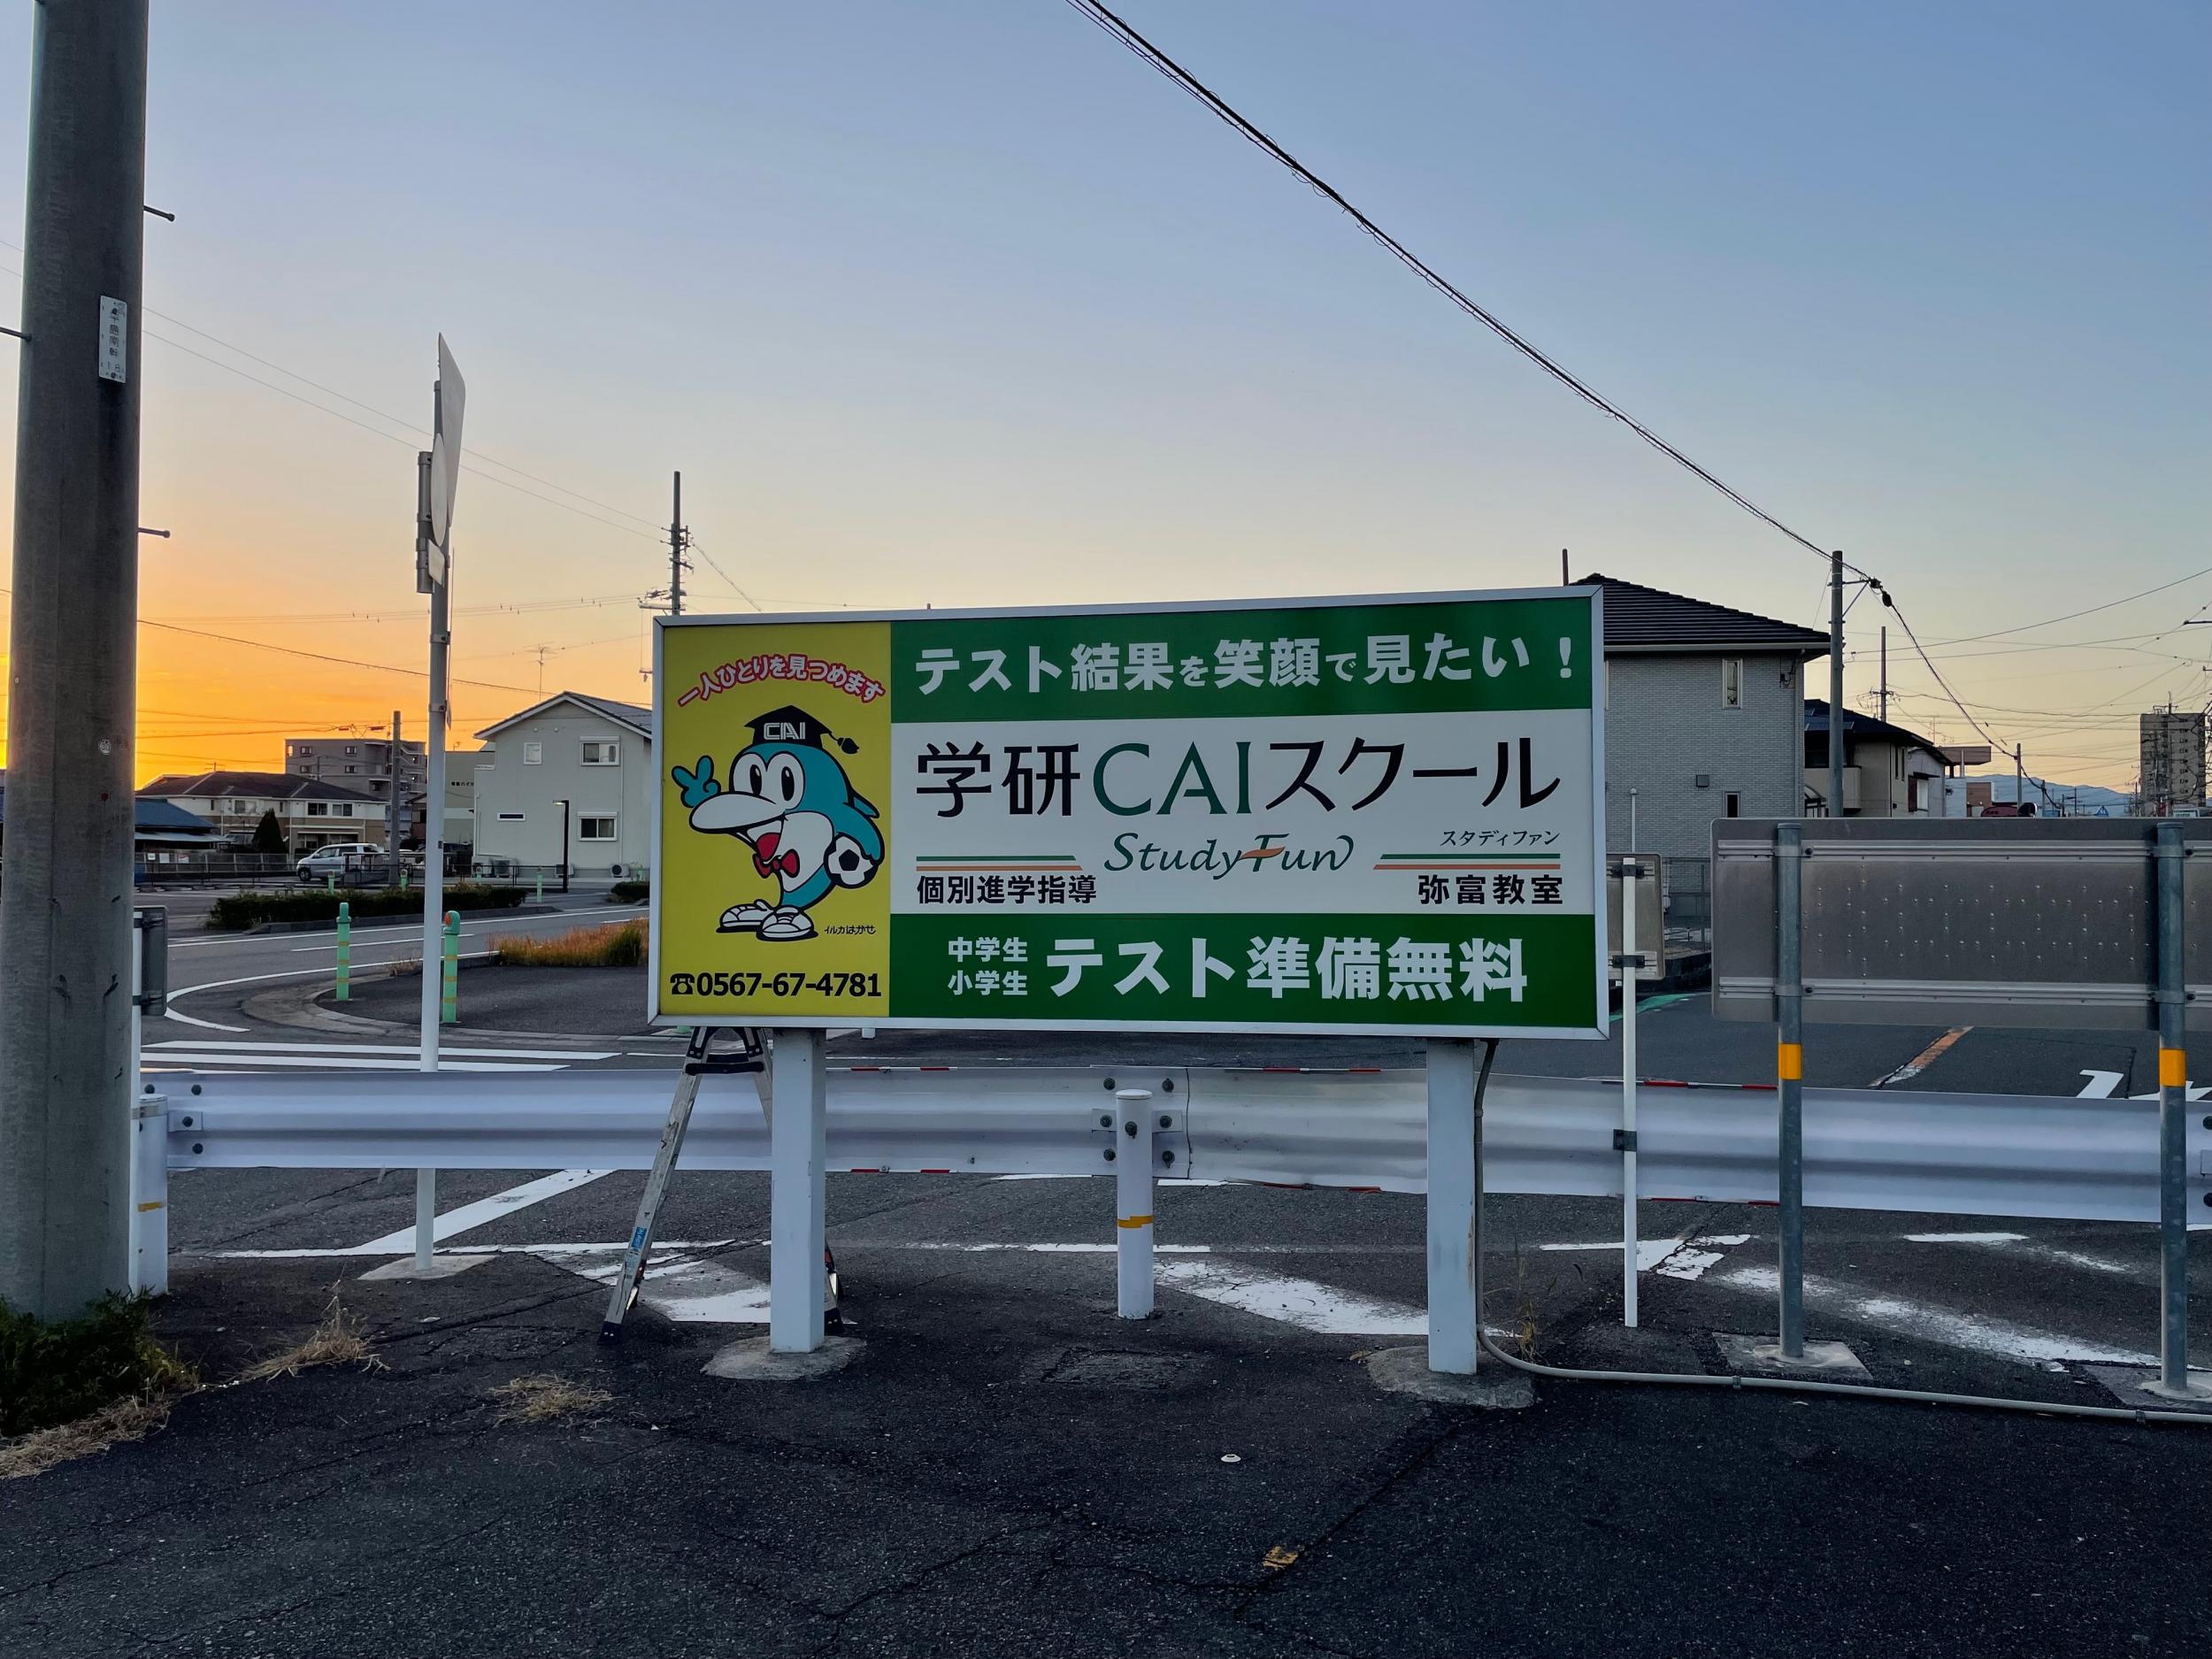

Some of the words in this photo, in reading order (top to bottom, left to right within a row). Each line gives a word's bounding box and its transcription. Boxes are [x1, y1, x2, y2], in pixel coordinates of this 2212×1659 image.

[677, 653, 887, 708] 一人ひとりを見つめます
[764, 722, 806, 741] CAI
[916, 736, 1562, 818] 学研CAIスクール
[1440, 830, 1561, 847] スタディファン
[917, 874, 1097, 904] 個別進学指導
[1417, 873, 1563, 905] 弥富教室
[824, 925, 877, 935] イルカはかせ
[948, 936, 1028, 963] 中学生
[948, 970, 1028, 995] 小学生
[1047, 936, 1527, 1002] テスト準備無料
[696, 972, 882, 997] 0567-67-4781
